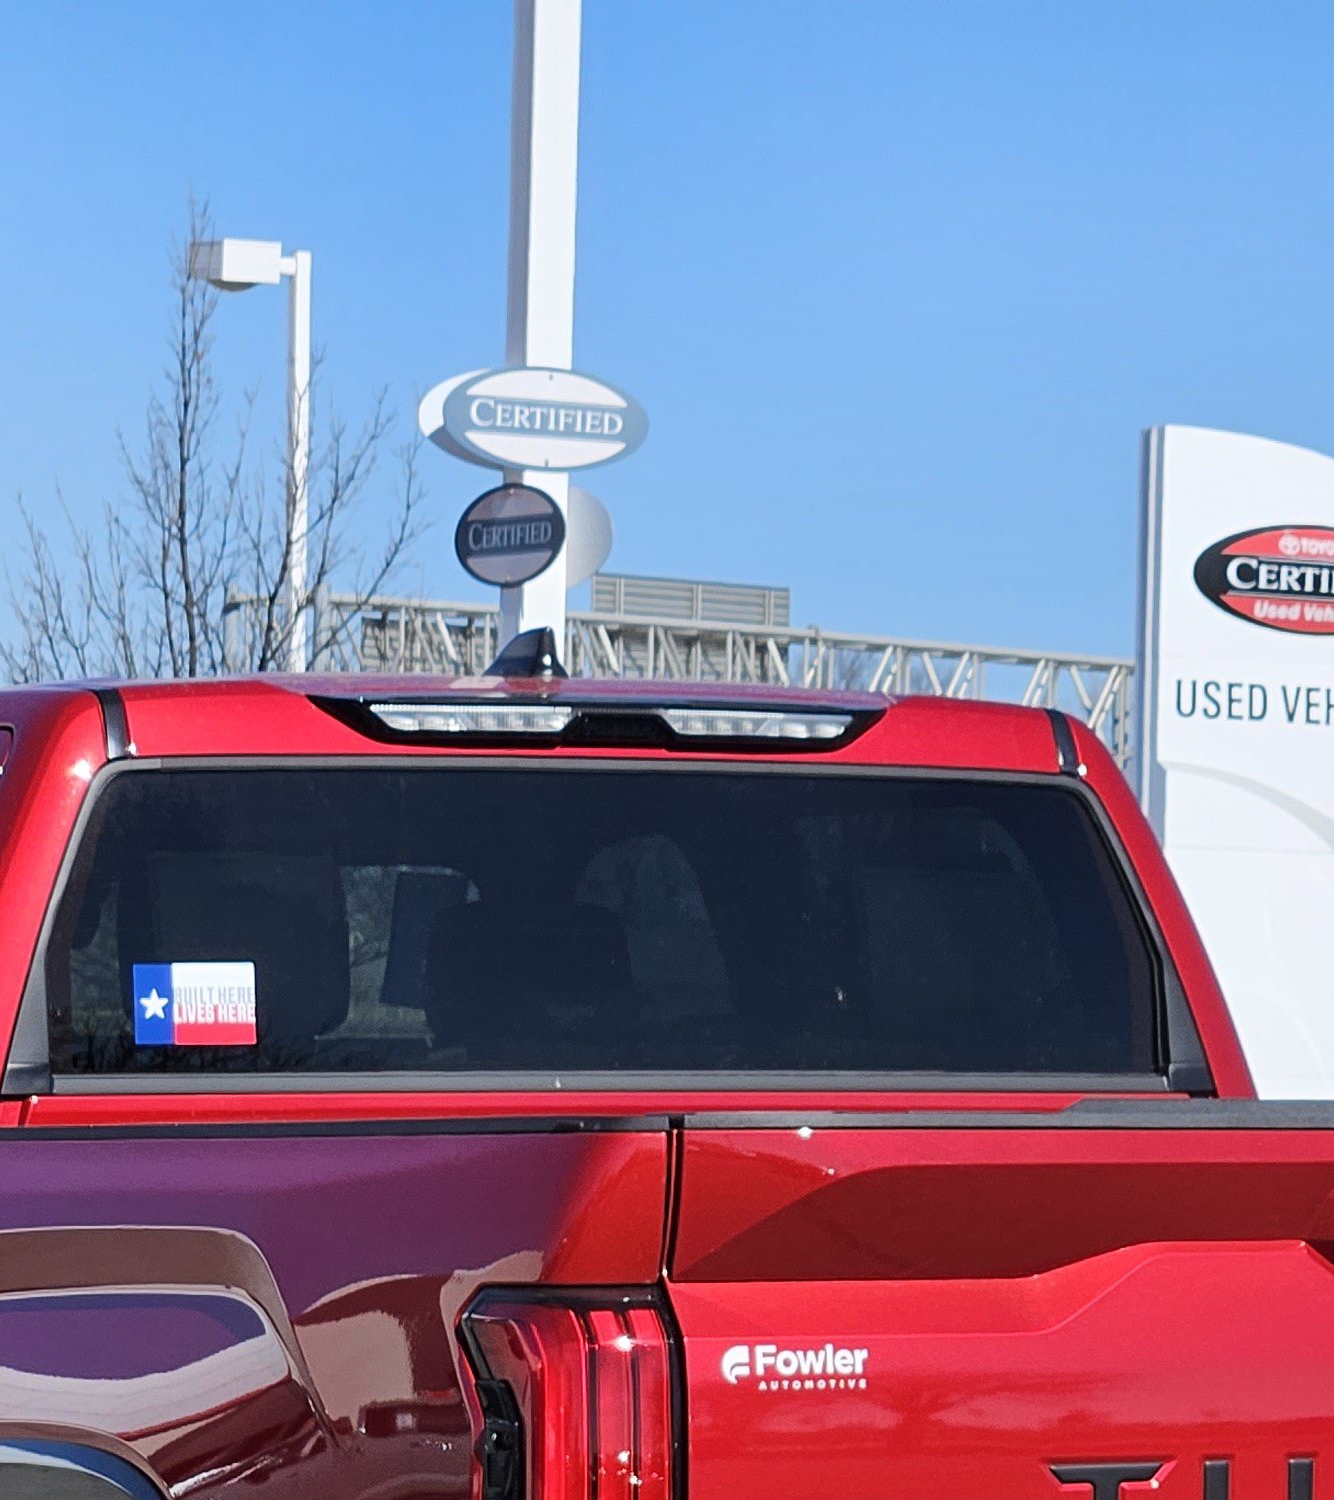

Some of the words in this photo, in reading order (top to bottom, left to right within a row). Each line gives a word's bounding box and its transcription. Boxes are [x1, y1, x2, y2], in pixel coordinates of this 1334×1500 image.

[470, 398, 624, 435] CERTIFIED
[468, 520, 553, 551] CERTIFIED
[1254, 600, 1301, 620] Used
[1176, 679, 1267, 720] USED
[754, 1343, 868, 1376] Fowler
[758, 1378, 867, 1391] AUTOMOTIVE
